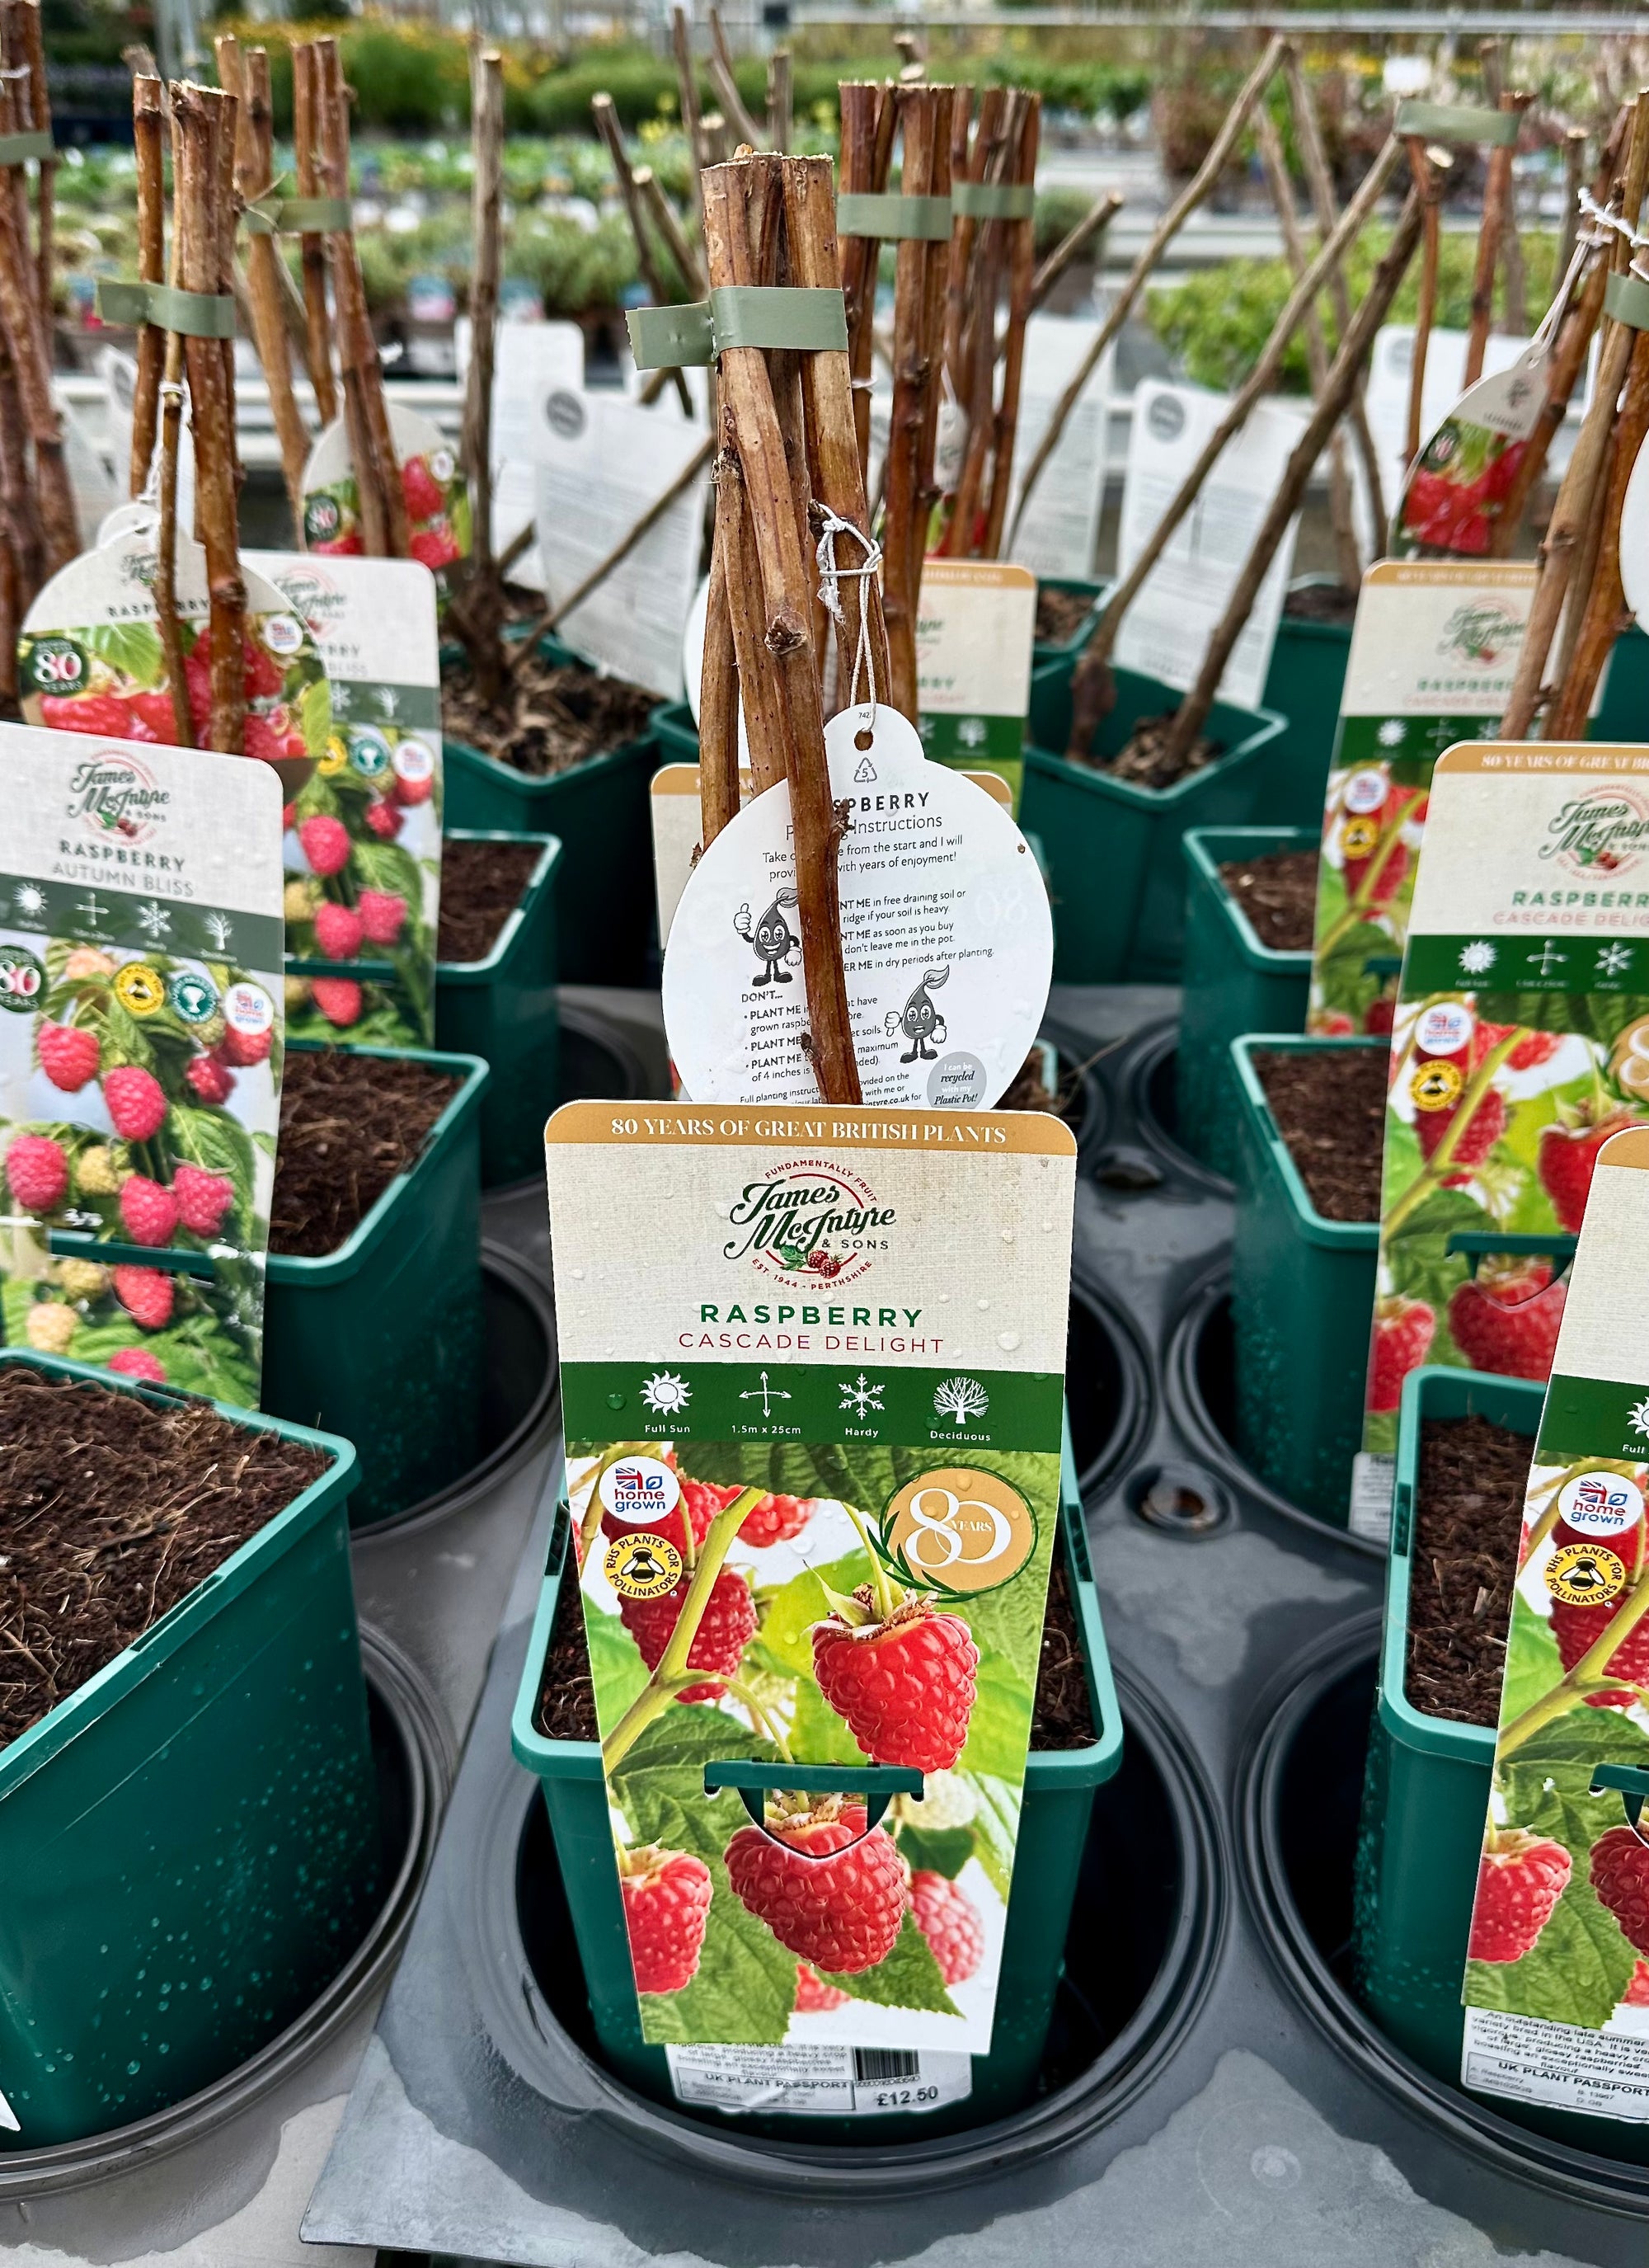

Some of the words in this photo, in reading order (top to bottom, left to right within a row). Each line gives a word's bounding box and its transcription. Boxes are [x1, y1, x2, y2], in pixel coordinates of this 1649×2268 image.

[69, 761, 136, 793] James
[1548, 798, 1630, 834] James
[853, 815, 942, 835] Instructions
[847, 844, 871, 855] from
[873, 841, 890, 853] the
[893, 840, 917, 851] start
[919, 837, 937, 849] and
[947, 834, 963, 846] will
[59, 838, 186, 873] RASPBERRY
[763, 851, 787, 863] Take
[859, 861, 886, 874] years
[889, 856, 900, 868] of
[901, 851, 956, 868] enjoyment!
[51, 862, 136, 887] AUTUMN
[143, 873, 195, 897] BLISS
[769, 866, 796, 882] provi
[856, 898, 871, 909] ME
[873, 898, 881, 906] in
[884, 896, 901, 906] free
[903, 892, 938, 904] draining
[940, 889, 955, 899] soil
[1512, 890, 1649, 908] RASPBERR
[843, 913, 866, 925] ridge
[867, 910, 875, 920] if
[875, 910, 895, 922] your
[897, 907, 912, 917] soil
[914, 907, 922, 915] is
[1492, 910, 1589, 925] CASCADE
[856, 929, 871, 939] ME
[885, 928, 906, 937] soon
[908, 926, 918, 934] as
[919, 924, 936, 935] you
[937, 921, 954, 932] buy
[870, 941, 893, 951] leave
[895, 940, 909, 948] me
[911, 939, 918, 947] in
[921, 936, 936, 945] the
[858, 960, 873, 971] ME
[875, 960, 883, 968] in
[886, 958, 900, 969] dry
[902, 953, 934, 967] periods
[936, 951, 956, 961] after
[857, 996, 878, 1006] have
[750, 1007, 785, 1020] PLANT
[786, 1005, 801, 1015] ME
[750, 1023, 779, 1036] grown
[751, 1038, 785, 1052] PLANT
[857, 1042, 899, 1054] maximum
[751, 1056, 786, 1069] PLANT
[787, 1053, 802, 1064] ME
[751, 1071, 763, 1082] of
[763, 1070, 770, 1080] 4
[772, 1067, 801, 1079] inches
[941, 1070, 975, 1085] recycled
[756, 1091, 788, 1103] planting
[865, 1087, 882, 1096] with
[911, 1093, 922, 1101] for
[933, 1094, 961, 1105] Plastic
[611, 1118, 638, 1136] 80
[643, 1118, 715, 1136] YEARS
[719, 1119, 750, 1136] OF
[754, 1120, 826, 1138] GREAT
[832, 1122, 917, 1141] BRITISH
[923, 1124, 1007, 1144] PLANTS
[763, 1159, 853, 1179] FUNDAMENTALLY
[853, 1177, 878, 1202] FRUIT
[729, 1179, 840, 1226] James
[723, 1207, 897, 1260] McIntyre
[821, 1239, 831, 1249] &
[841, 1239, 890, 1250] SONS
[751, 1258, 769, 1274] EST
[773, 1274, 798, 1288] 1944
[810, 1260, 872, 1291] PERTHSHIRE
[700, 1304, 923, 1328] RASPBERRY
[679, 1333, 810, 1350] CASCADE
[825, 1335, 944, 1354] DELIGHT
[645, 1424, 666, 1433] Full
[669, 1424, 691, 1433] Sun
[731, 1425, 759, 1434] 1.5m
[772, 1425, 801, 1435] 25cm
[845, 1428, 880, 1438] Hardy
[930, 1431, 991, 1442] Deciduous
[1622, 1443, 1645, 1455] Full
[614, 1489, 665, 1500] home
[615, 1500, 666, 1513] grown
[1573, 1499, 1626, 1517] home
[951, 1519, 993, 1532] YEARS
[1570, 1511, 1624, 1526] grown
[904, 1488, 1012, 1568] 80
[606, 1548, 621, 1569] RHS
[618, 1536, 665, 1550] PLANTS
[664, 1547, 679, 1568] FOR
[1546, 1554, 1564, 1574] RHS
[1564, 1546, 1614, 1561] PLANTS
[1609, 1561, 1623, 1581] FOR
[609, 1571, 679, 1597] POLLINATORS
[1546, 1577, 1618, 1603] POLLINATORS
[1598, 2035, 1646, 2047] summer
[1498, 2061, 1519, 2072] UK
[1523, 2066, 1570, 2082] PLANT
[705, 2073, 723, 2082] UK
[727, 2077, 771, 2087] PLANT
[775, 2080, 849, 2090] PASSPORT
[876, 2085, 938, 2106] £12.50
